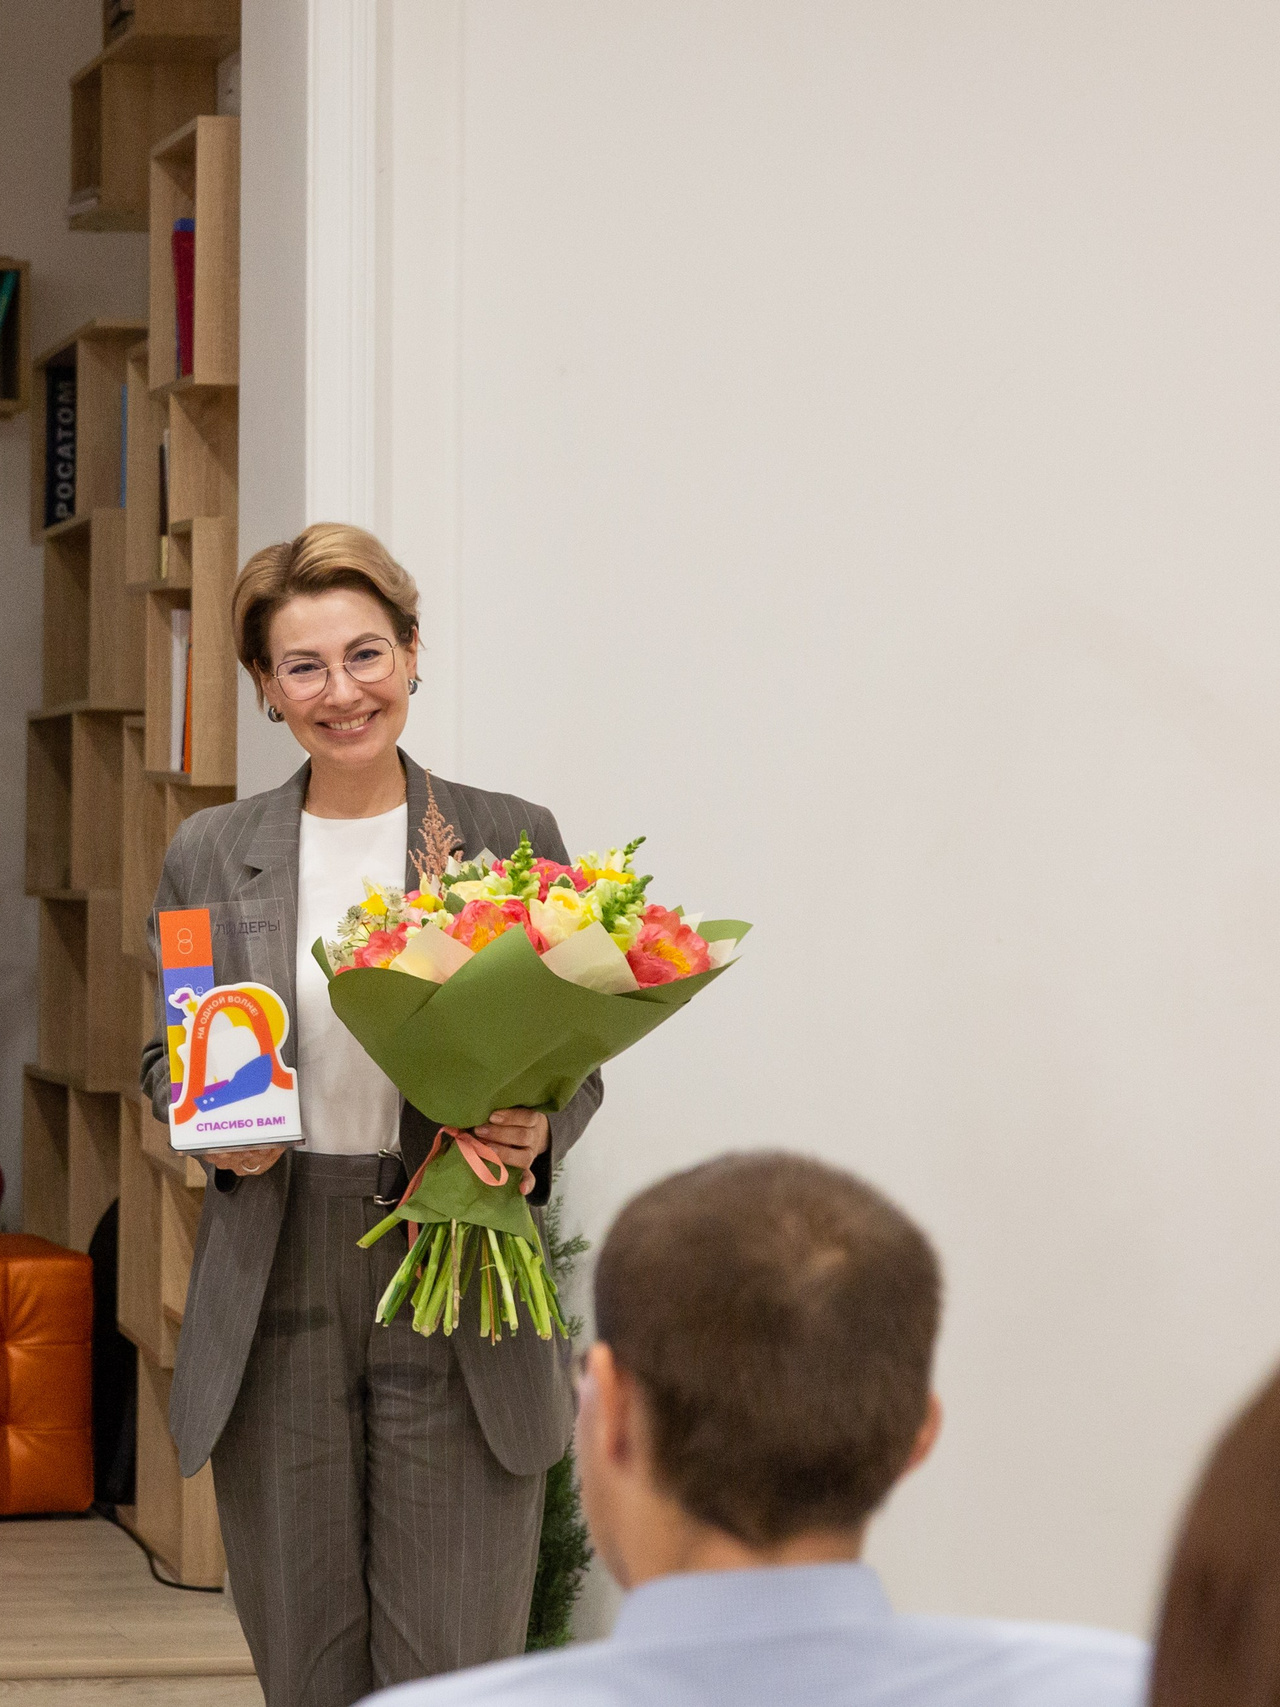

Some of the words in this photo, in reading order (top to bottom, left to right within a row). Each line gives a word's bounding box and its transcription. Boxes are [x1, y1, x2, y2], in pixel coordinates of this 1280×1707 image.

[55, 379, 74, 520] РОСАТОМ
[214, 920, 281, 936] ЛИДЕРЫ
[200, 996, 226, 1025] ОДНОЙ
[227, 995, 259, 1017] ВОЛНЕ!
[197, 1026, 206, 1039] НА
[196, 1118, 254, 1132] СПАСИБО
[256, 1116, 286, 1127] ВАМ!
